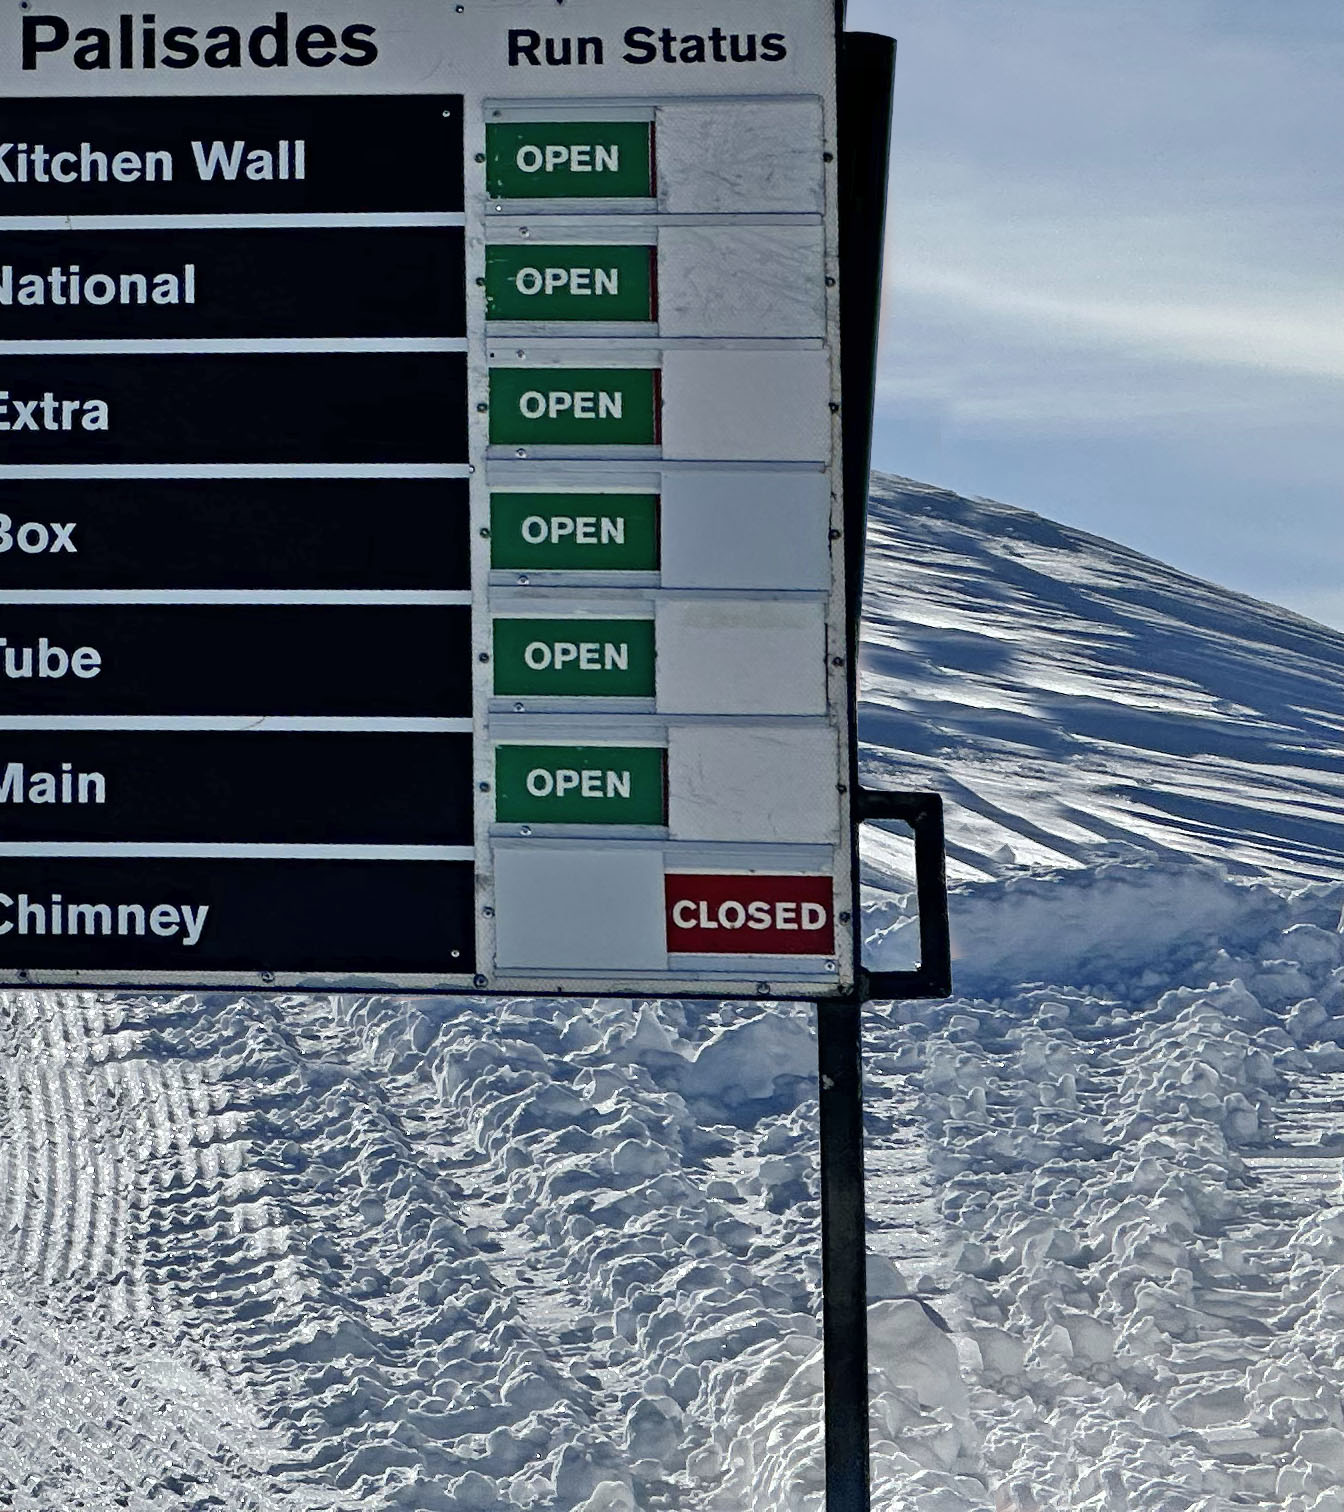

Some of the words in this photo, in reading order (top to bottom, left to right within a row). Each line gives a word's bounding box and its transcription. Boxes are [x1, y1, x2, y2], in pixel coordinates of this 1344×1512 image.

[21, 11, 379, 71] Palisades
[507, 28, 604, 67] Run
[622, 25, 787, 65] Status
[190, 139, 306, 181] Wall
[516, 144, 619, 173] OPEN
[515, 267, 618, 296] OPEN
[519, 390, 623, 419] OPEN
[521, 515, 625, 545] OPEN
[524, 641, 629, 671] OPEN
[526, 768, 631, 798] OPEN
[672, 899, 827, 931] CLOSED
